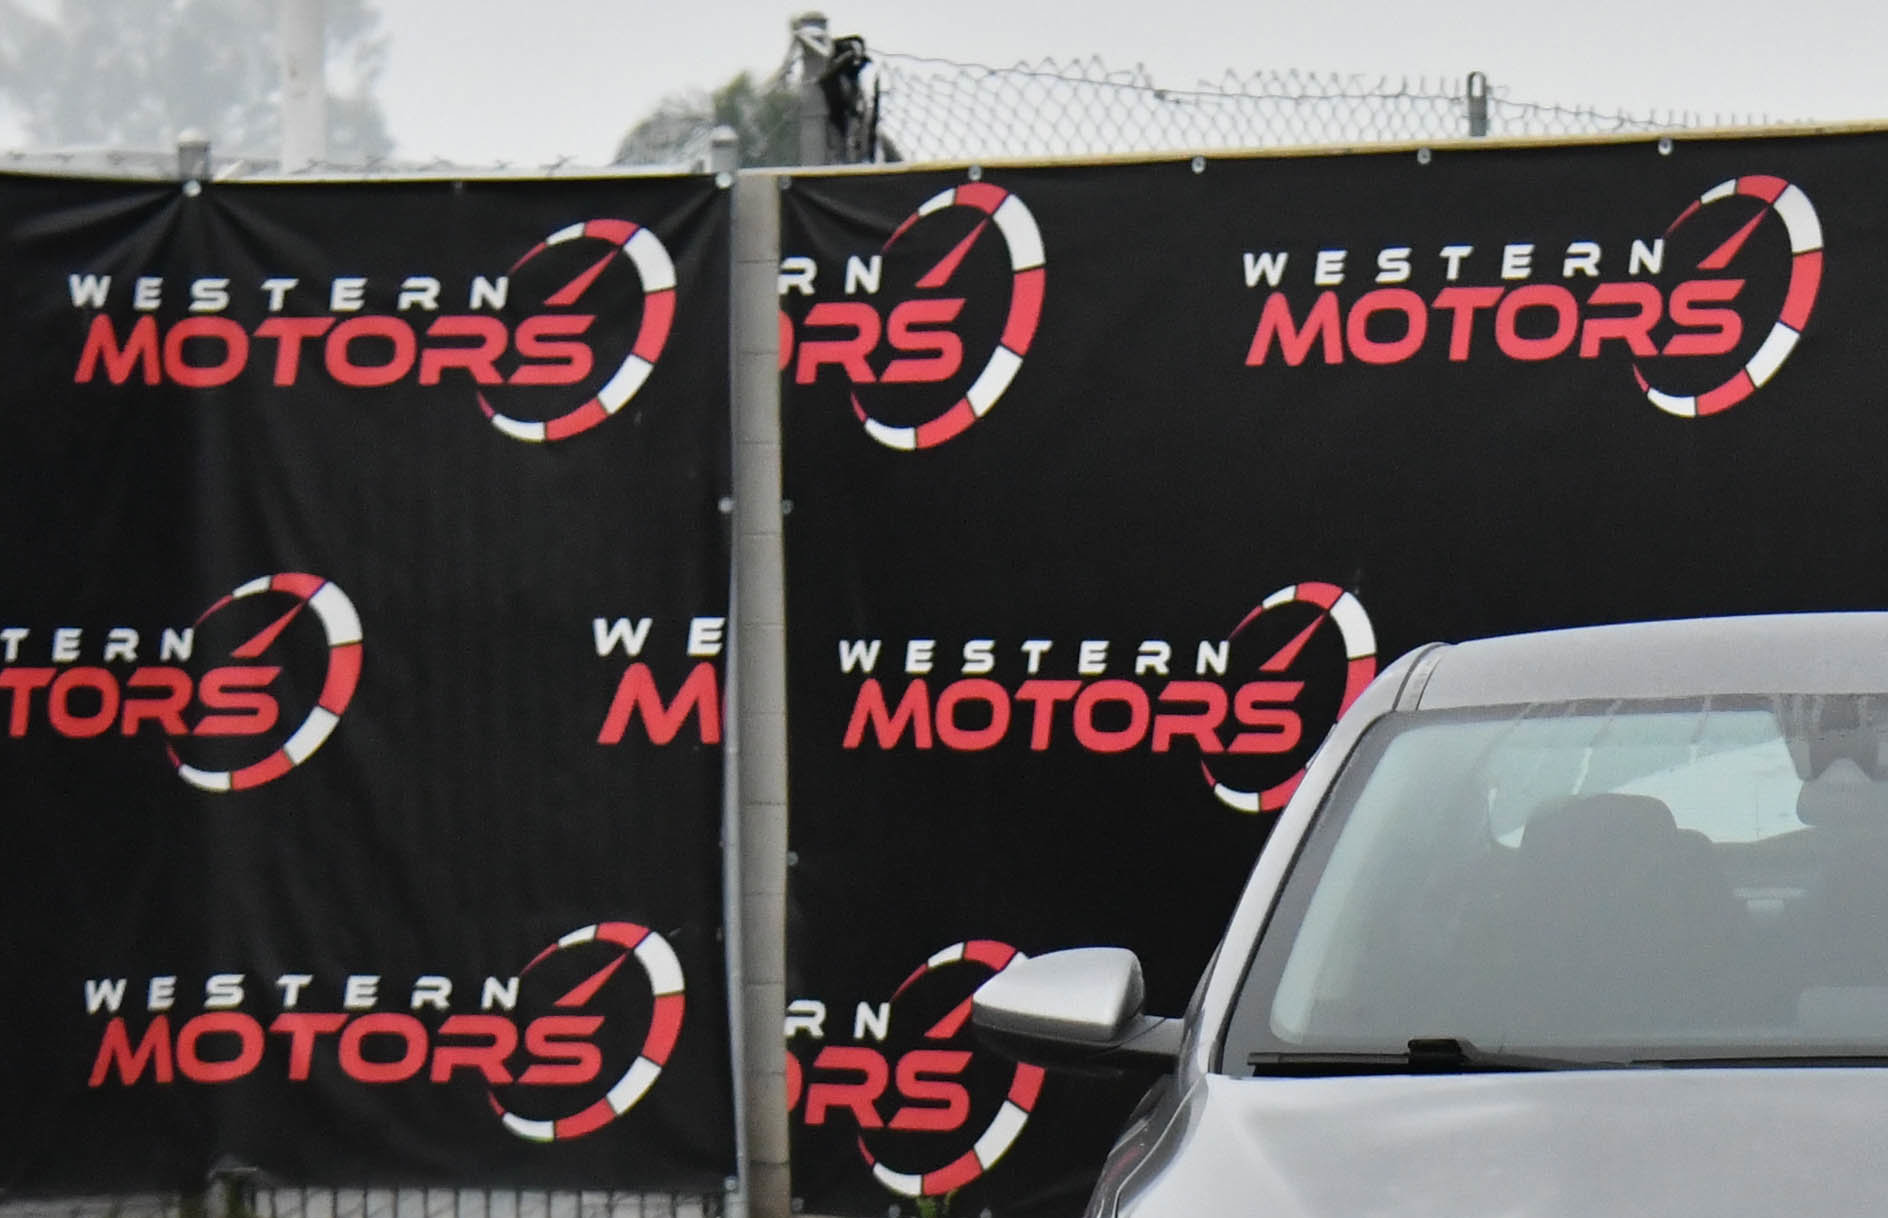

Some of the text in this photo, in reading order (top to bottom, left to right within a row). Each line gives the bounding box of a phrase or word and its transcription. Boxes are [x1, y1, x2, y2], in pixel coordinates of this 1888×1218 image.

[1244, 239, 1664, 287] WESTERN
[70, 275, 508, 312] WESTERN
[1246, 280, 1744, 366] MOTORS
[75, 315, 595, 388] MOTORS
[0, 627, 195, 662] TERN
[593, 617, 726, 657] WE
[839, 639, 1229, 674] WESTERN
[0, 666, 281, 738] TORS
[597, 661, 721, 746] M
[842, 678, 1305, 754] MOTORS
[86, 975, 519, 1012] WESTERN
[90, 1013, 605, 1086] MOTORS
